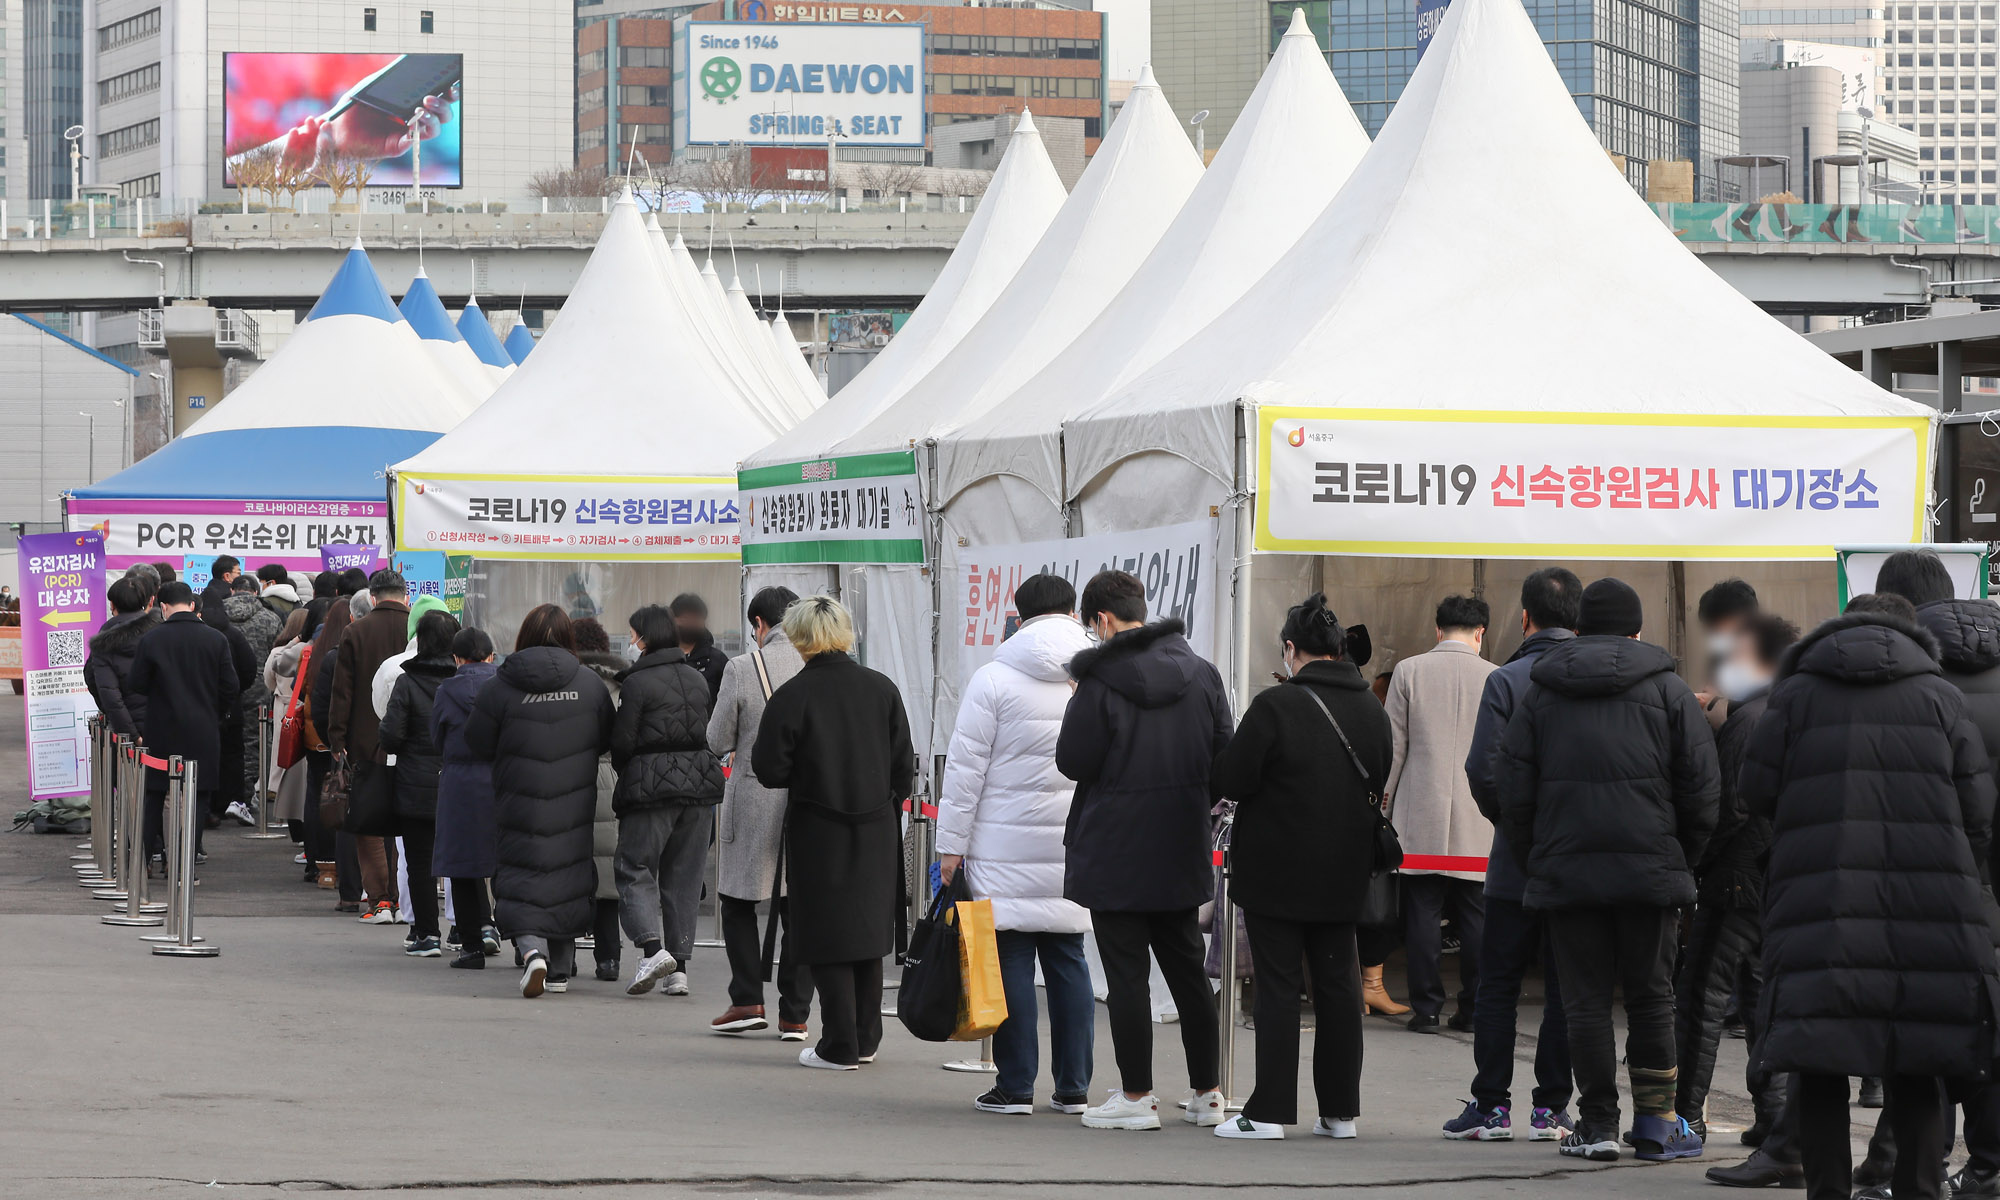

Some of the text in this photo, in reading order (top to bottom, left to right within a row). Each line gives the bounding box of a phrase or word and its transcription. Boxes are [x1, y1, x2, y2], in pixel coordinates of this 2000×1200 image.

[700, 34, 779, 49] Since 1946
[750, 63, 914, 94] DAEWON
[750, 115, 824, 135] SPRING
[851, 115, 902, 135] SEAT
[189, 398, 205, 407] P14
[1308, 432, 1335, 443] 서울중구
[1312, 462, 1879, 510] 코로나19 신속항원검사 대기장소
[244, 503, 350, 516] 코로나바이러스감염증
[467, 498, 740, 525] 코로나19 신속항원검사소
[762, 492, 815, 534] 신속항원검사
[820, 488, 851, 531] 완료자
[856, 486, 890, 530] 대기실
[137, 523, 376, 549] PCR 우선순위 대상자
[439, 531, 486, 543] 신청서작성
[513, 534, 551, 544] 키트배부
[579, 535, 616, 546] 자가검사
[644, 535, 682, 546] 검체제출
[710, 535, 729, 545] 대기
[29, 552, 96, 574] 유전자검사
[328, 554, 370, 571] 유전자검사
[44, 573, 82, 589] (PCR)
[418, 580, 440, 596] 서울역
[38, 588, 91, 607] 대상자
